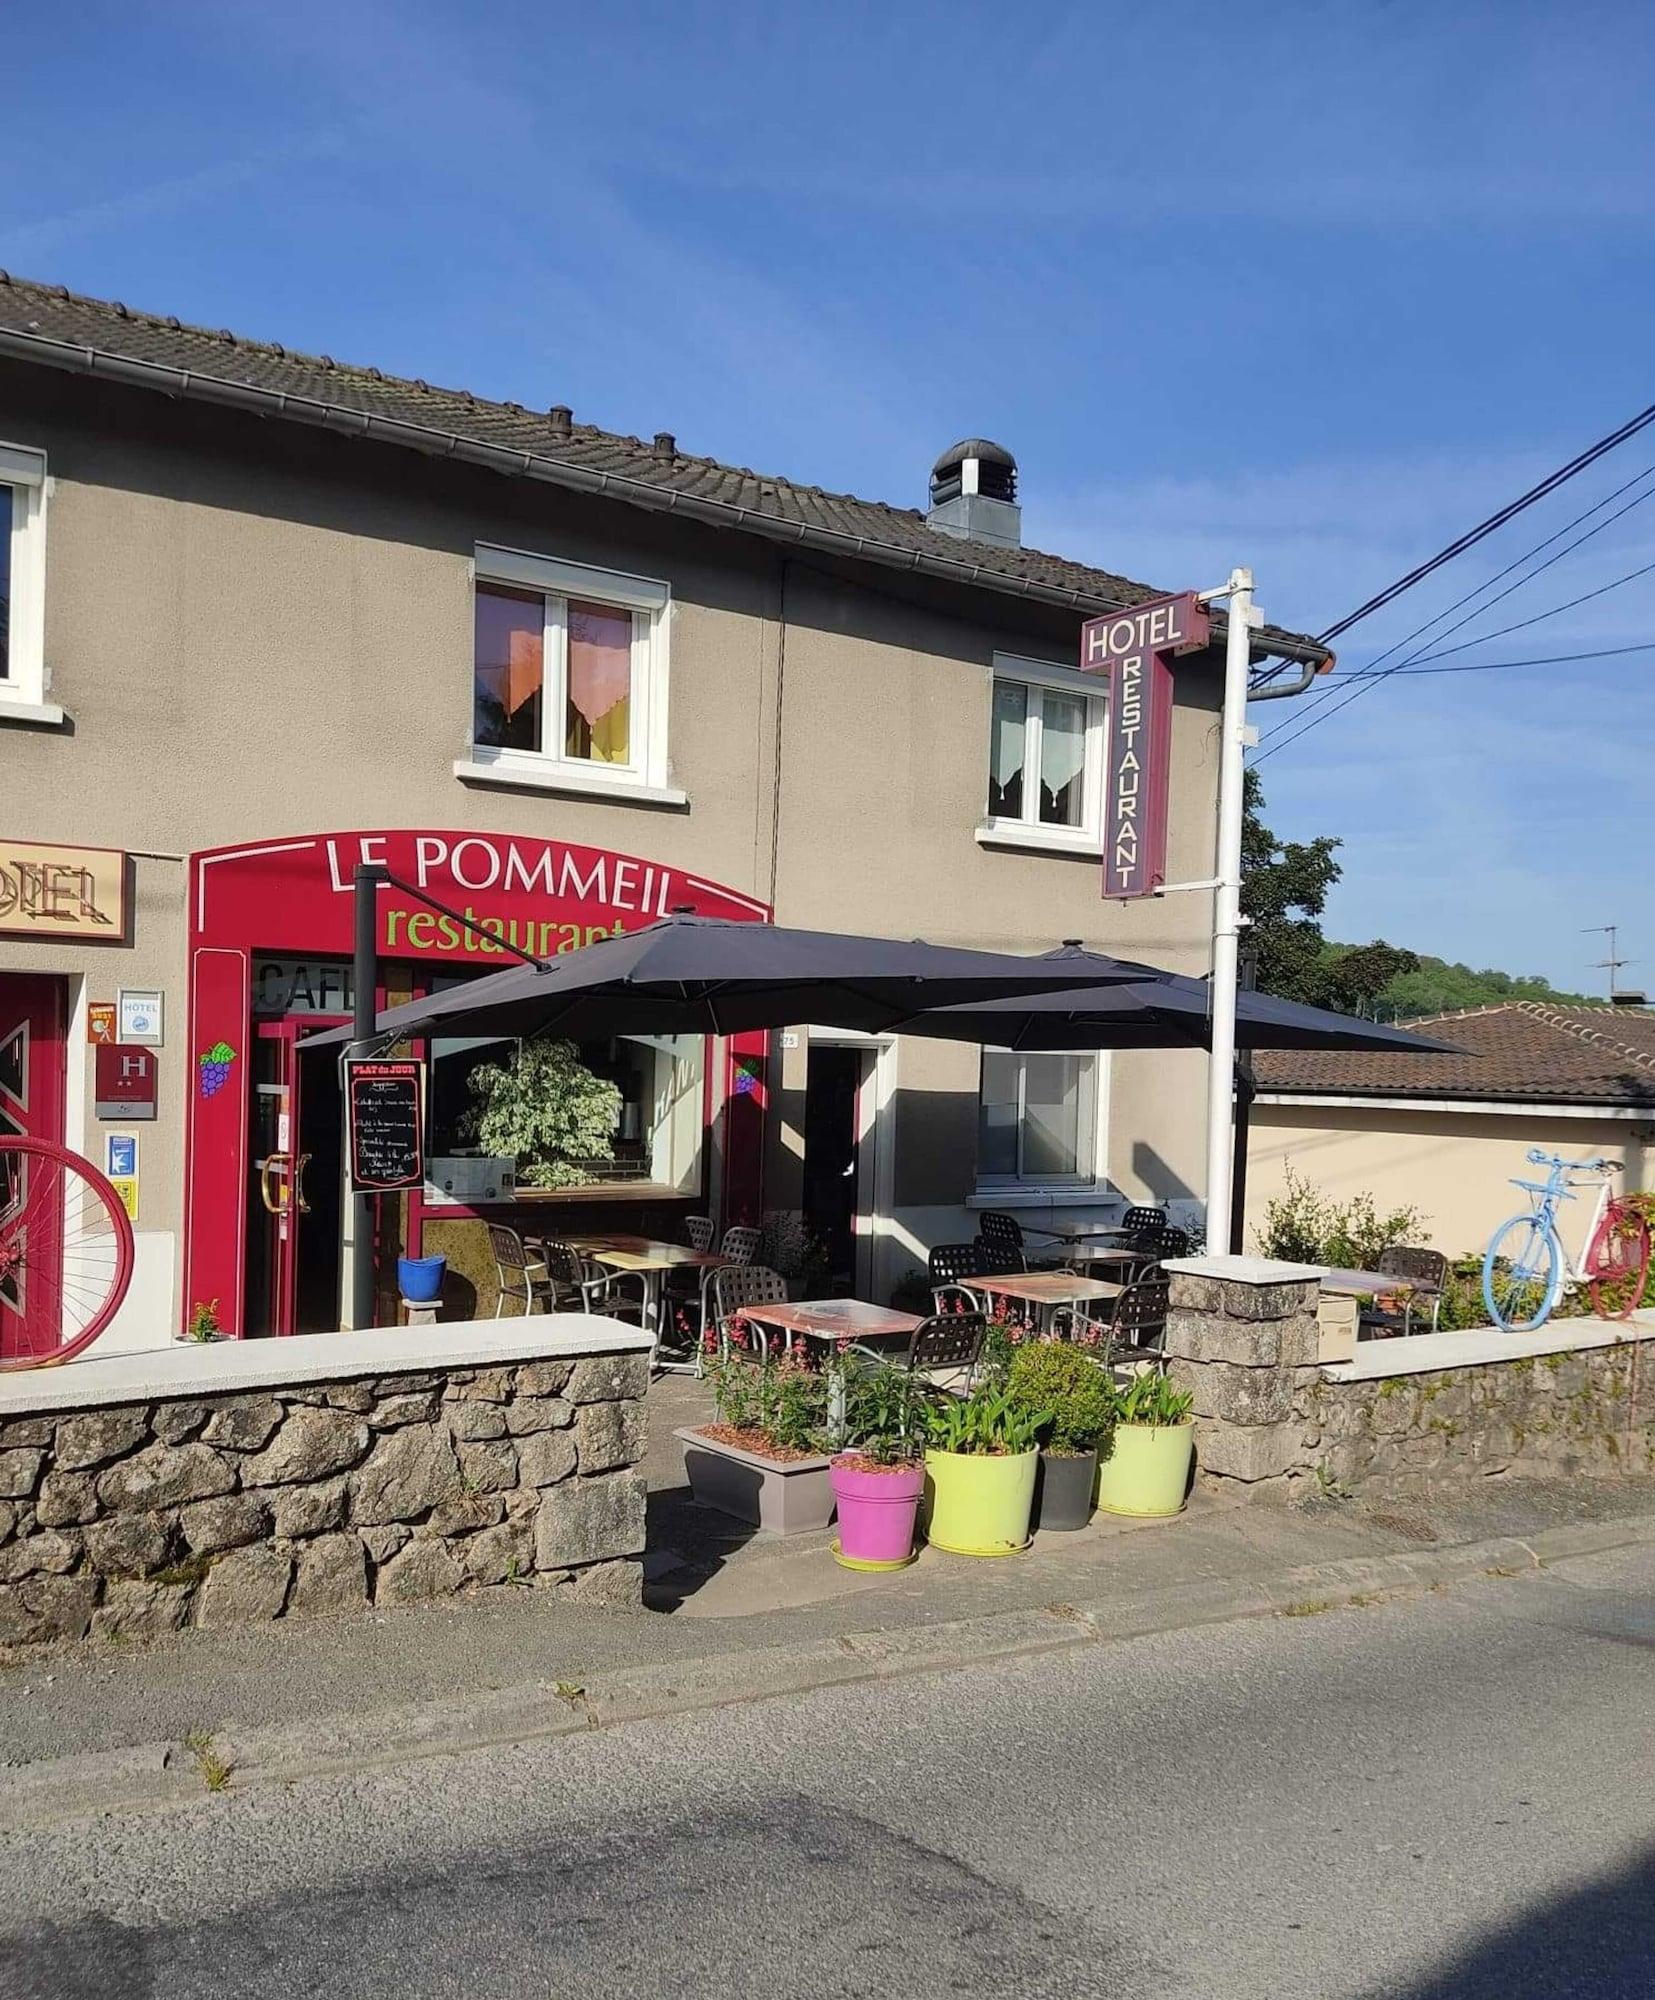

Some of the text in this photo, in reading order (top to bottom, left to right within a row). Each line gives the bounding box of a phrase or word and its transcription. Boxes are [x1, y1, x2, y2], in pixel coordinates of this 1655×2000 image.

[1088, 605, 1182, 662] HOTEL
[1115, 655, 1142, 889] RESTAURANT
[327, 837, 674, 919] LE POMMEIL
[121, 1055, 148, 1078] H
[352, 1064, 378, 1075] PLAT
[389, 1064, 416, 1075] JOUR
